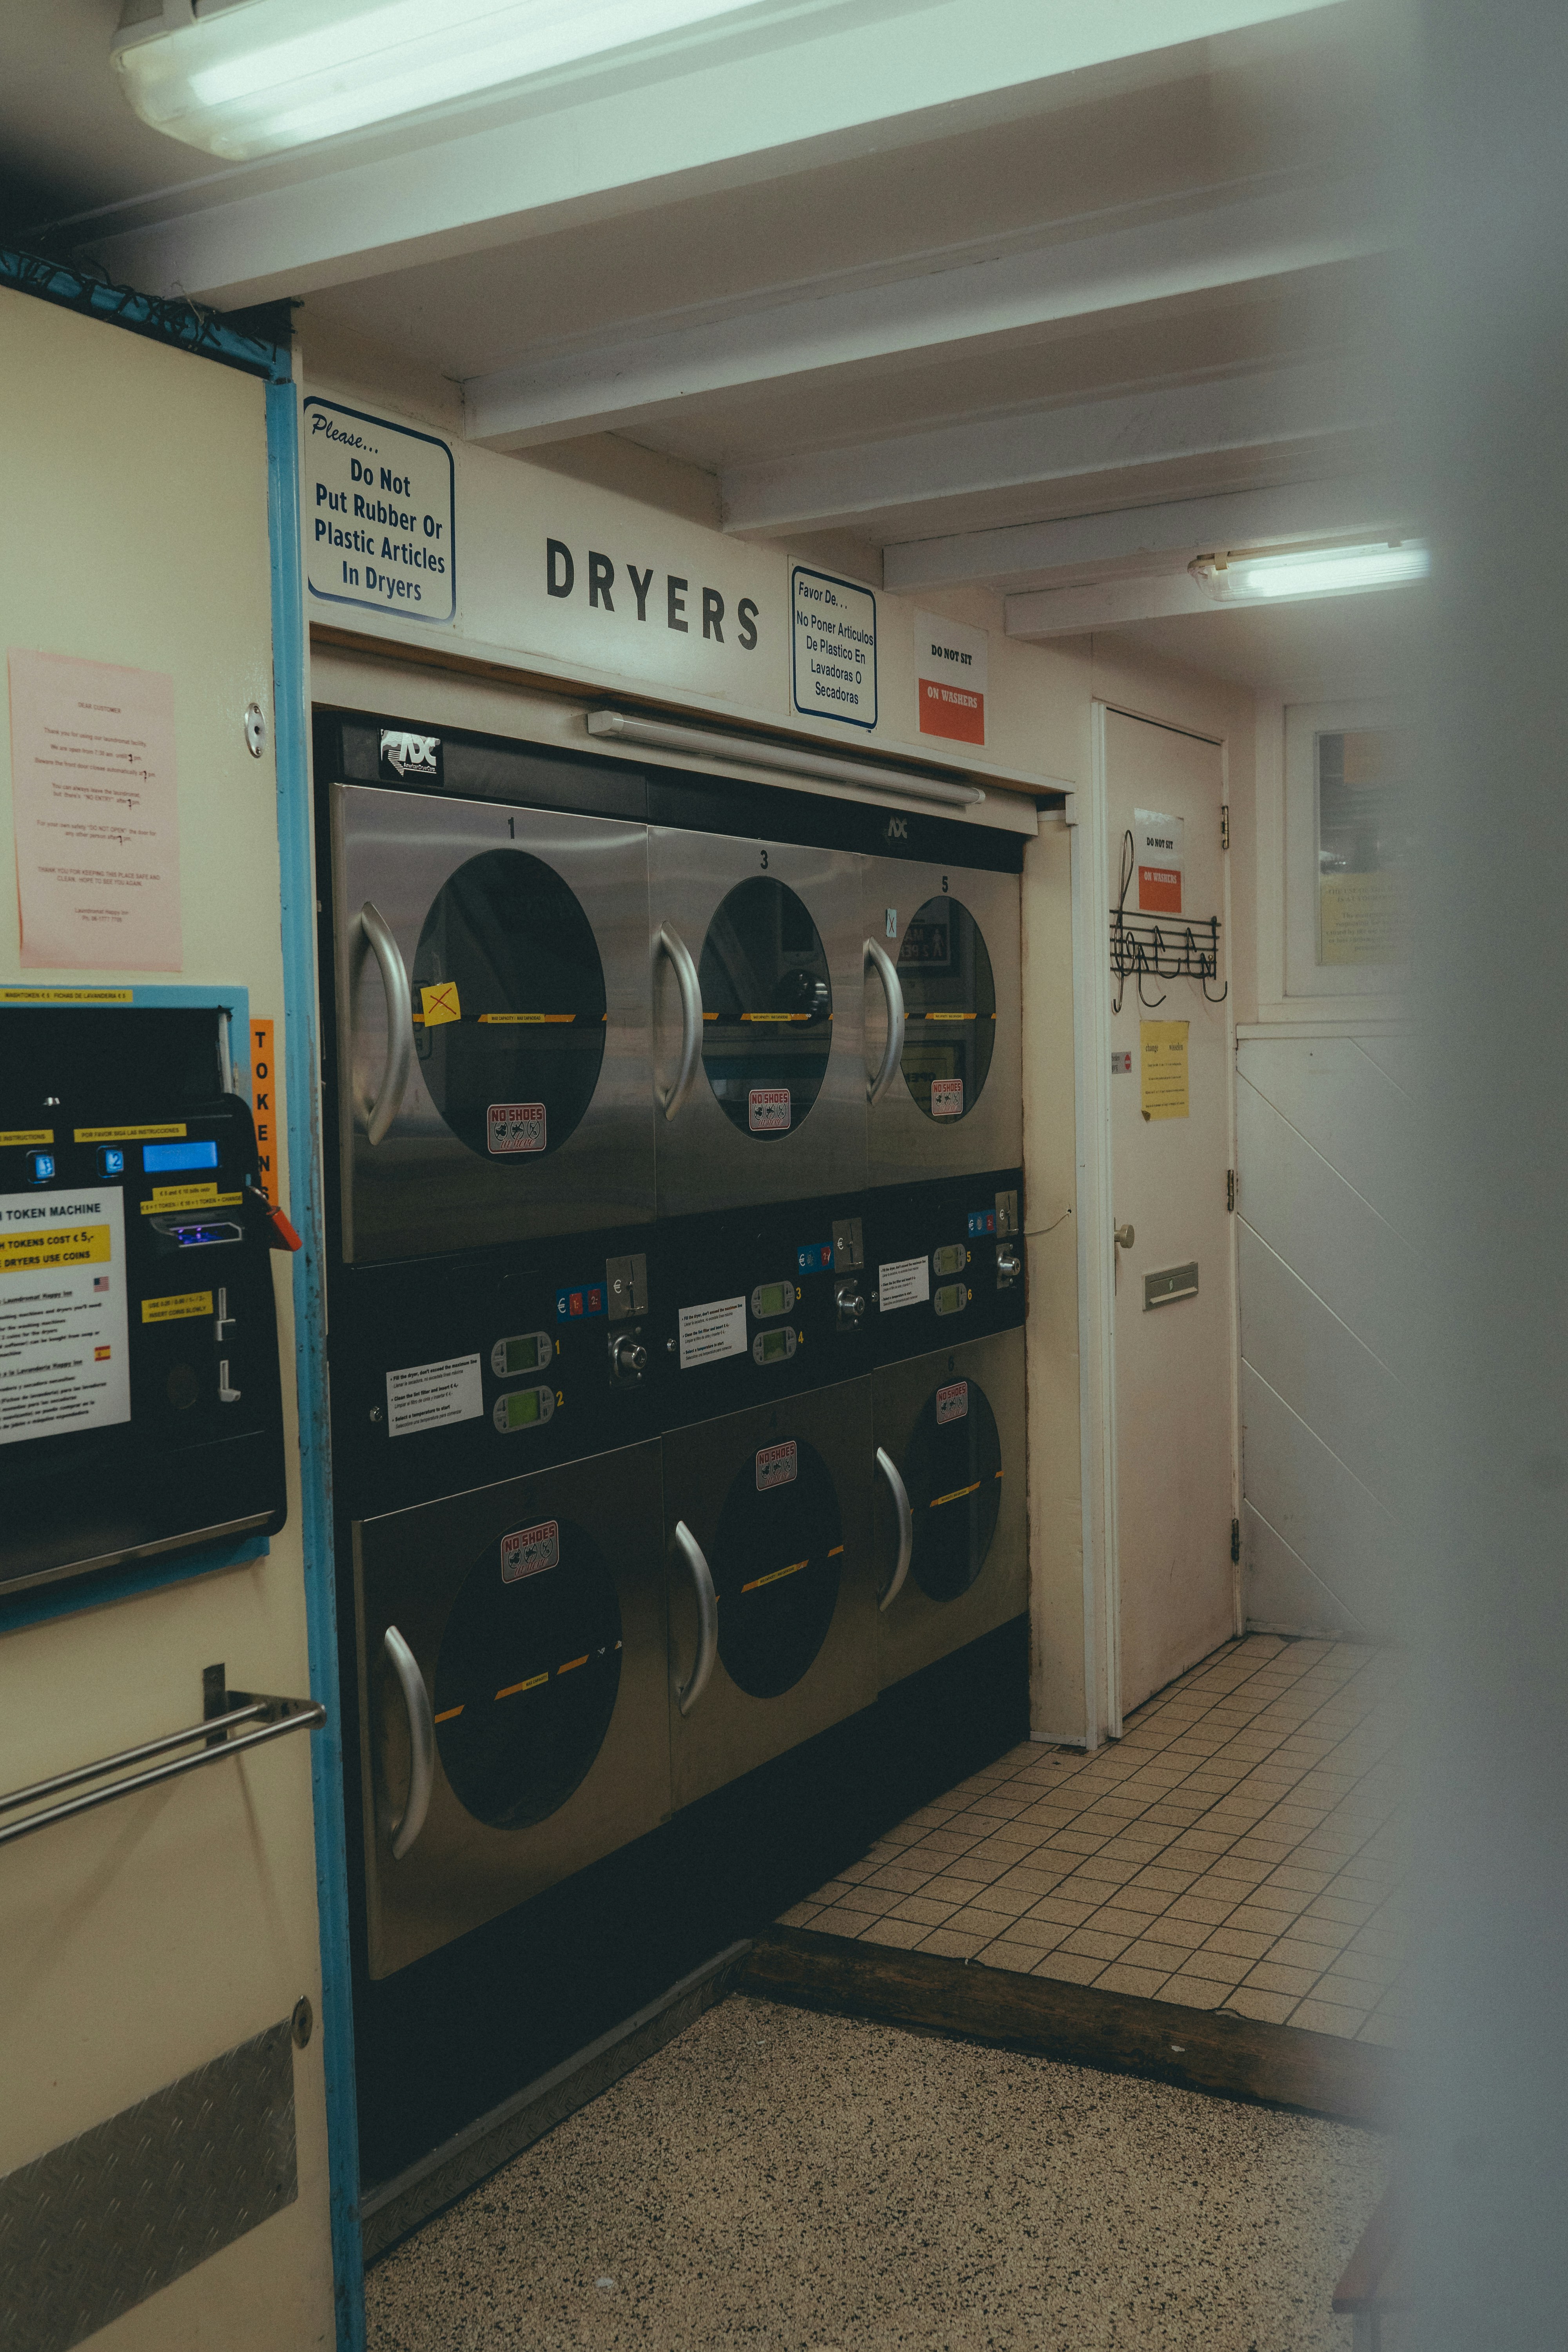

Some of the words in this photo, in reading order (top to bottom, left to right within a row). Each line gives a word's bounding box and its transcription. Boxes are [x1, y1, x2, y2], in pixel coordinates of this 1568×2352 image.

[312, 414, 379, 454] Please...
[351, 458, 374, 485] Do
[381, 467, 411, 497] Not
[316, 483, 347, 513] Put
[354, 494, 417, 531] Rubber
[423, 515, 443, 539] Or
[315, 519, 374, 555] Plastic
[381, 537, 445, 573] Articles
[343, 561, 359, 586] In
[366, 566, 422, 601] Dryers
[546, 537, 759, 651] DRYERS
[799, 581, 823, 601] Favor
[797, 610, 809, 627] No
[811, 615, 836, 634] Poner
[838, 622, 873, 646] Articulos
[806, 635, 818, 651] De
[820, 639, 853, 661] Plastico
[855, 649, 866, 664] En
[931, 644, 942, 657] DO
[944, 648, 960, 662] NOT
[961, 653, 972, 666] SIT
[811, 659, 853, 682] Lavadoras
[855, 671, 862, 684] O
[815, 681, 859, 705] Secadoras
[927, 686, 939, 700] ON
[941, 690, 977, 708] WASHERS
[508, 817, 515, 839] 1
[1147, 837, 1154, 846] DO
[1155, 838, 1165, 848] NOT
[760, 849, 768, 870] 3
[942, 876, 948, 893] 5
[1144, 871, 1151, 881] ON
[1153, 871, 1177, 884] WASHERS
[1145, 1044, 1158, 1053] change
[934, 1084, 942, 1093] NO
[943, 1083, 961, 1092] SHOES
[752, 1094, 762, 1104] NO
[764, 1093, 788, 1103] SHOES
[492, 1109, 506, 1122] NO
[509, 1108, 543, 1121] SHOES
[767, 1113, 782, 1126] here
[500, 1137, 512, 1149] in
[513, 1132, 536, 1149] here
[113, 1153, 121, 1167] 2
[6, 1208, 46, 1220] TOKEN
[50, 1203, 101, 1216] MACHINE
[999, 1209, 1004, 1220] €
[969, 1219, 974, 1230] €
[8, 1238, 44, 1249] TOKENS
[47, 1236, 71, 1245] COST
[837, 1238, 844, 1250] €
[4, 1256, 40, 1267] DRYERS
[43, 1254, 60, 1263] USE
[63, 1251, 90, 1261] COINS
[799, 1254, 805, 1267] €
[967, 1251, 971, 1262] 5
[613, 1279, 622, 1294] €
[796, 1287, 801, 1300] 3
[968, 1289, 972, 1300] 6
[557, 1298, 566, 1314] €
[798, 1331, 804, 1344] 4
[555, 1339, 560, 1354] 1
[556, 1390, 564, 1407] 2
[939, 1392, 946, 1401] NO
[947, 1385, 966, 1399] SHOES
[412, 1409, 436, 1418] temperature
[759, 1454, 769, 1465] NO
[771, 1445, 795, 1460] SHOES
[505, 1539, 519, 1552] NO
[522, 1526, 555, 1548] SHOES
[528, 1555, 548, 1573] here
[533, 1675, 548, 1685] CAPACITY
